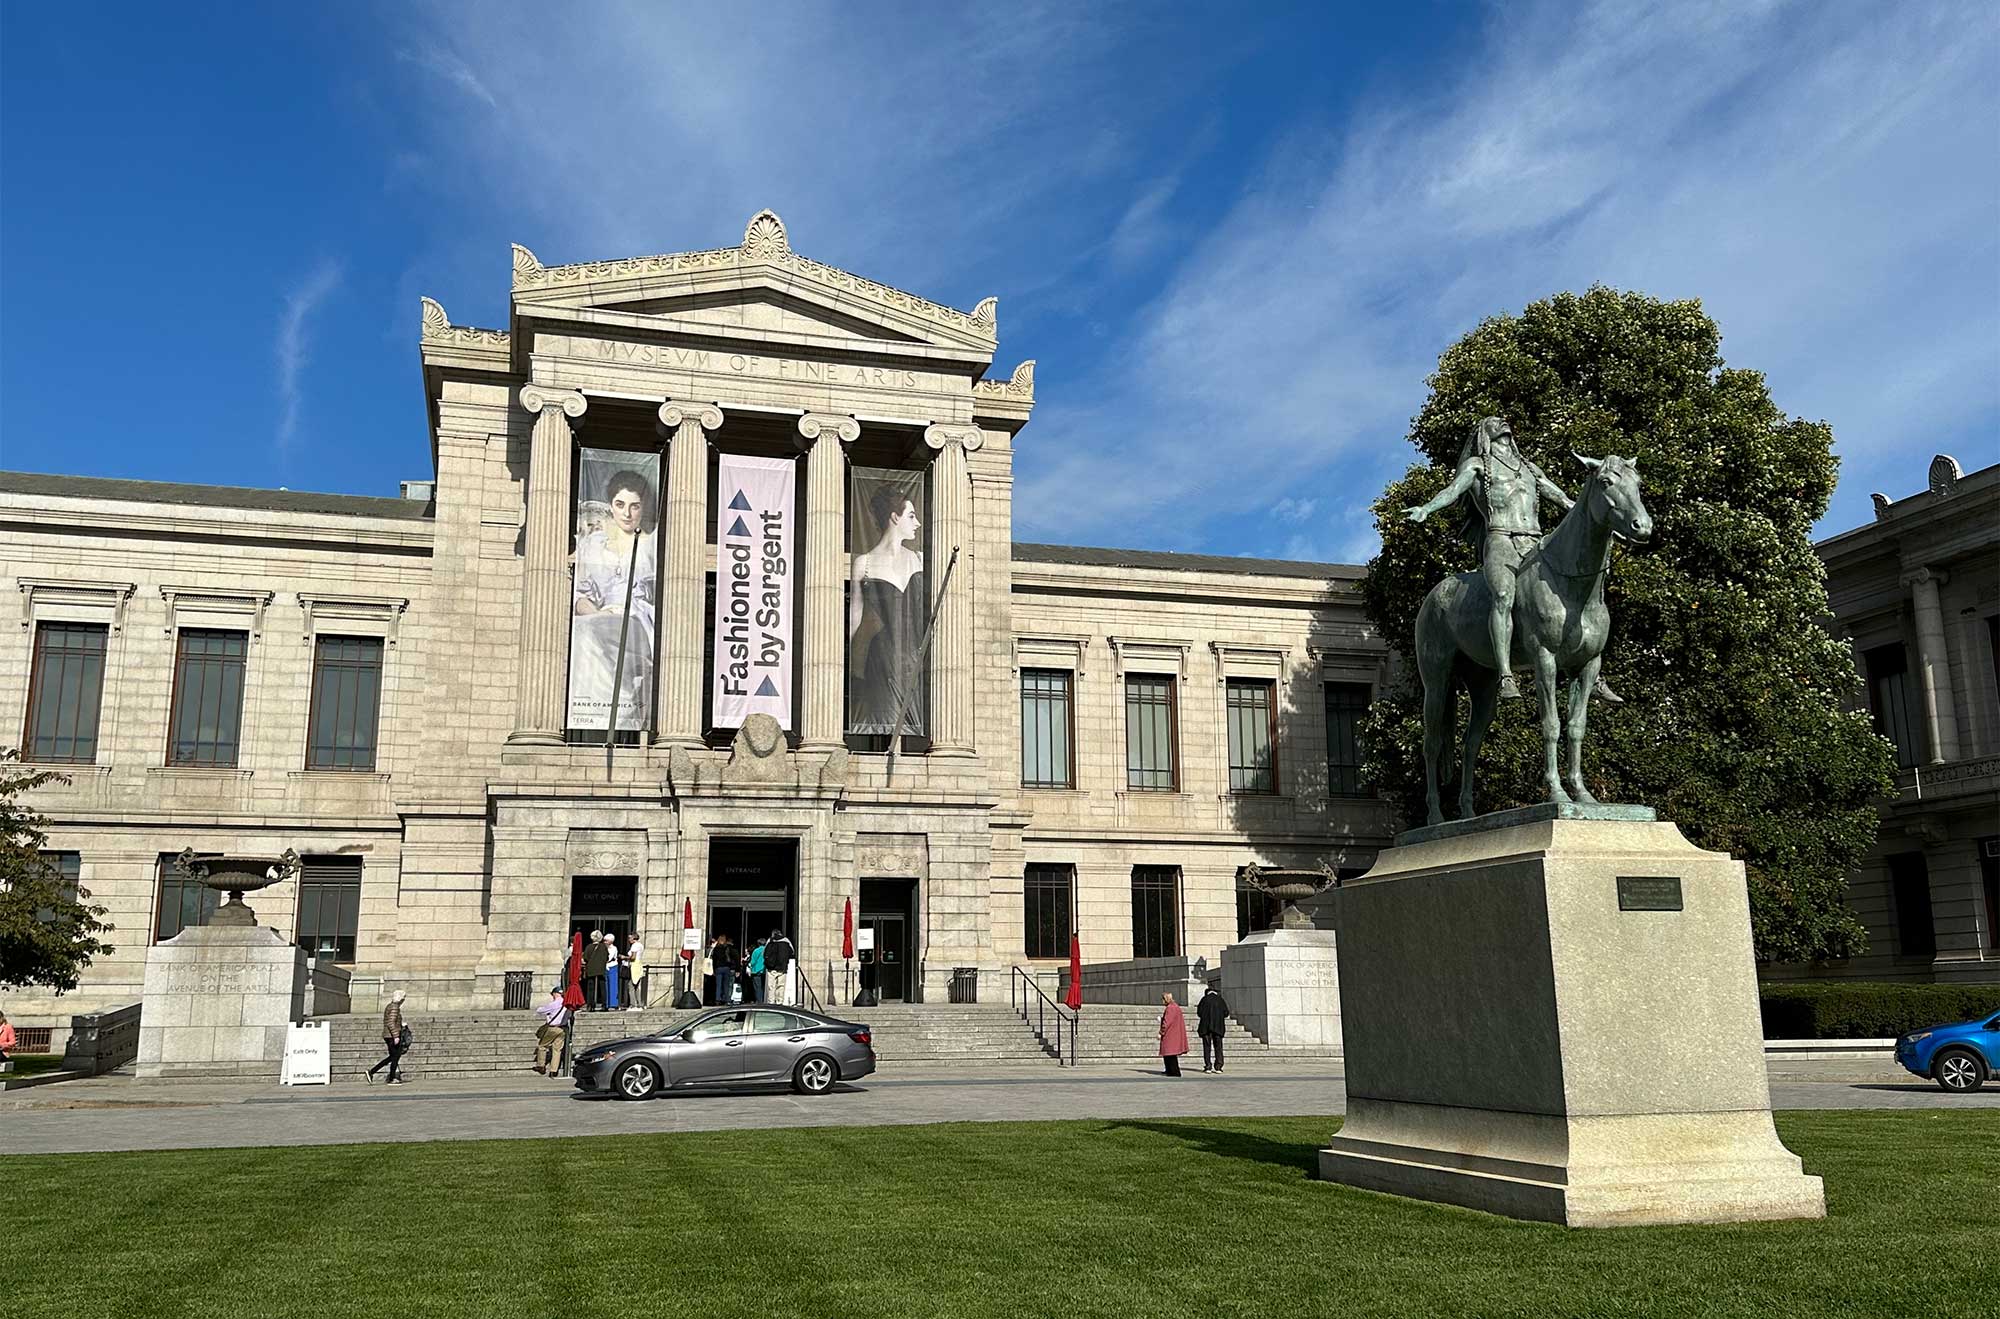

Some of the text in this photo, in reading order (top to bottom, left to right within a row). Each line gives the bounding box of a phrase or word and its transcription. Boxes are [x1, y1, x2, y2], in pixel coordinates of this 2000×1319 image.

[598, 341, 916, 387] MVSEVM OF FINE ARTS
[753, 509, 787, 667] by Sargent
[720, 543, 751, 696] Fashioned
[168, 984, 269, 992] AVENUE OF THE ARTS
[200, 974, 239, 982] ON THE
